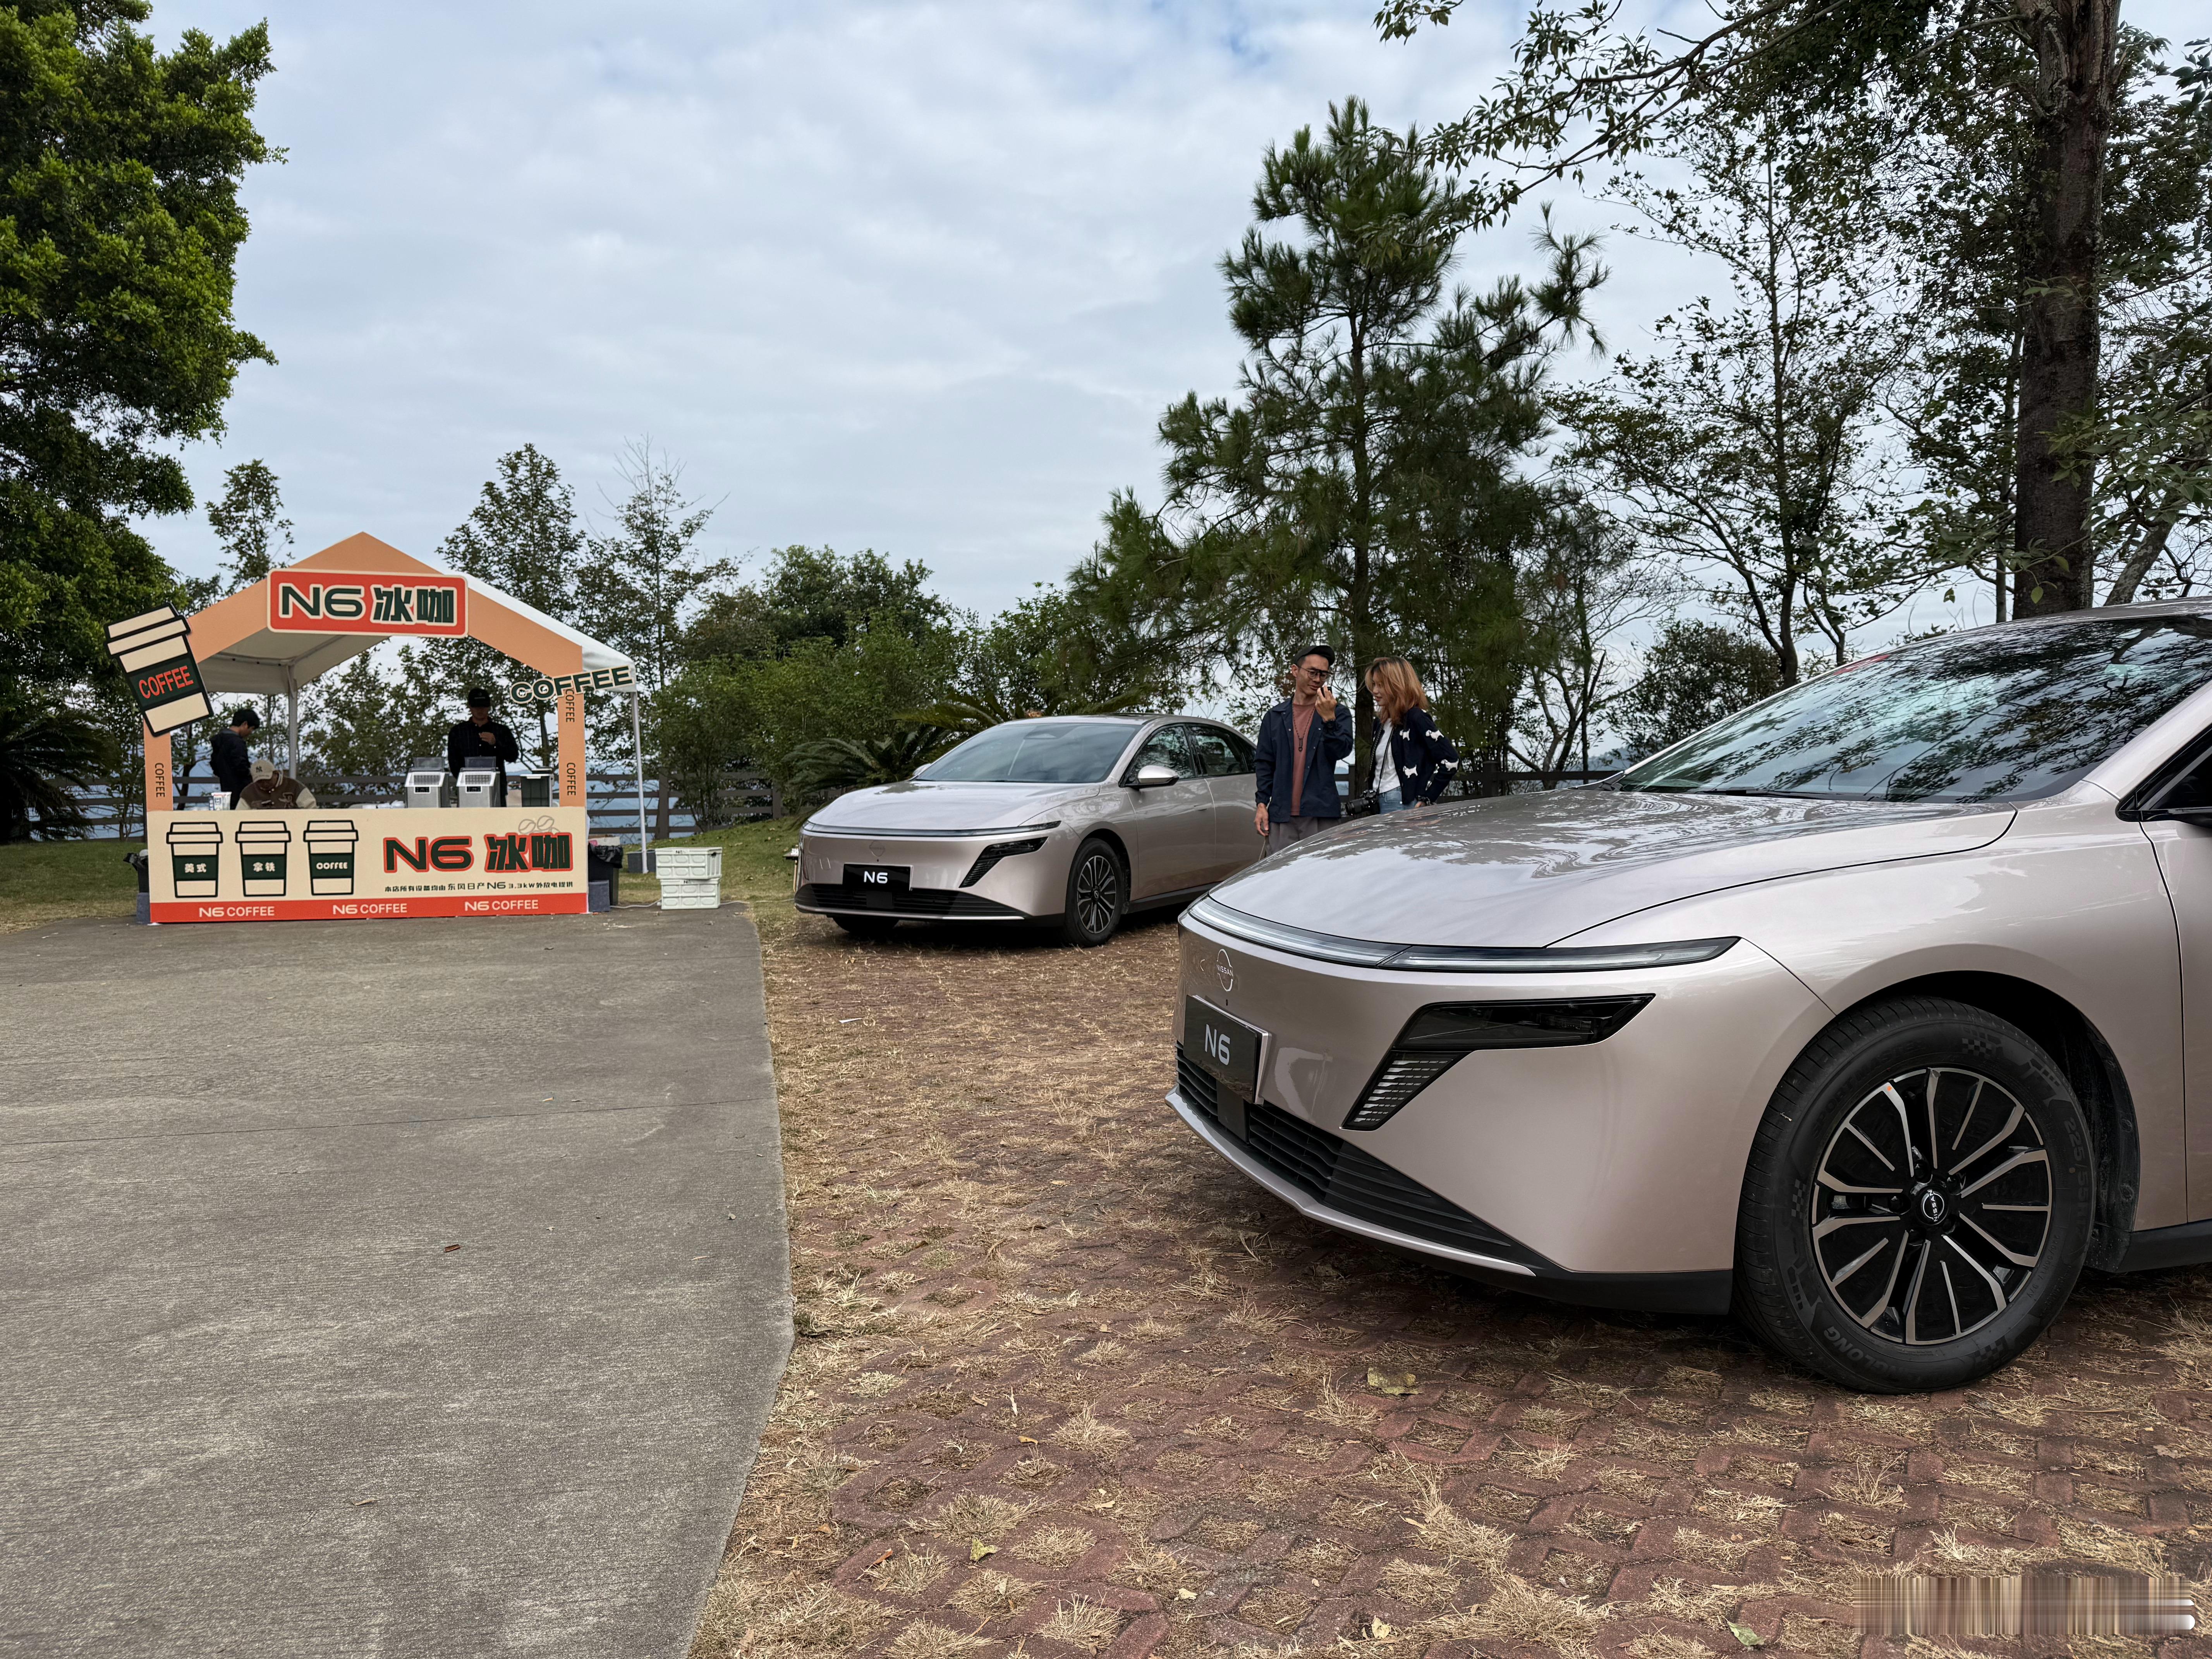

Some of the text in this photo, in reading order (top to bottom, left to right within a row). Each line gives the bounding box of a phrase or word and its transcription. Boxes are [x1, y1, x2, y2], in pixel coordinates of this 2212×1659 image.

[281, 585, 455, 623] N6 冰咖
[138, 665, 194, 699] COFFEE
[511, 666, 632, 702] COFFEE
[565, 689, 575, 723] COFFEE
[155, 762, 165, 798] COFFEE
[566, 762, 576, 796] COFFEE
[185, 863, 206, 873] 美式
[253, 862, 275, 872] 拿铁
[385, 834, 571, 871] N6 冰咖
[864, 871, 888, 884] N6
[199, 906, 275, 917] N6 COFFEE
[333, 903, 407, 914] N6 COFFEE
[465, 900, 538, 911] N6 COFFEE
[1216, 964, 1233, 977] NISSAN
[1205, 1024, 1230, 1065] N6
[1927, 1189, 1938, 1222] NISSAN
